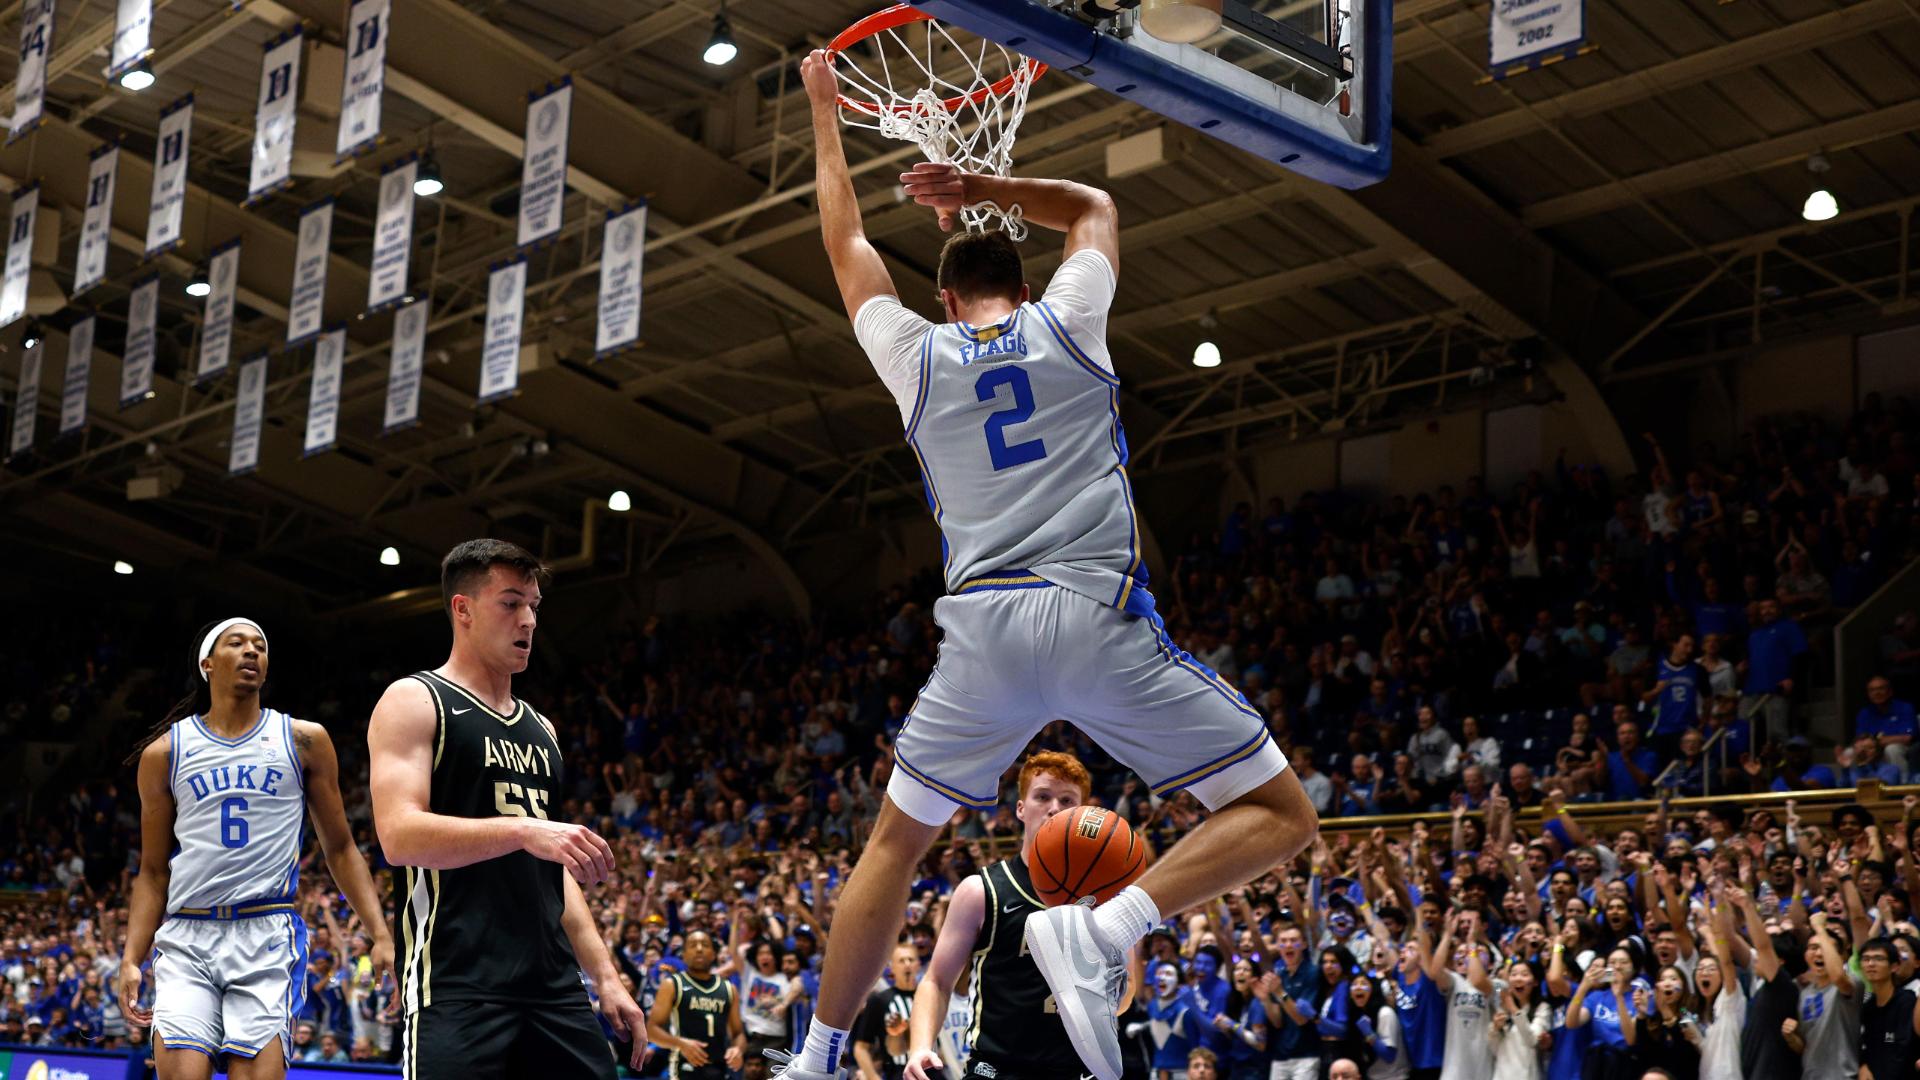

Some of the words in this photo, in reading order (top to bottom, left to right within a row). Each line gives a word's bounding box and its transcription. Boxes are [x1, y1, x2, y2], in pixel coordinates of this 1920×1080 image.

[1518, 24, 1554, 46] 2002
[959, 332, 1028, 366] FLAGG
[975, 365, 1047, 471] 2
[484, 736, 551, 777] ARMY
[187, 765, 283, 802] DUKE
[221, 797, 249, 849] 6
[689, 995, 726, 1014] ARMY
[705, 1014, 715, 1038] 1
